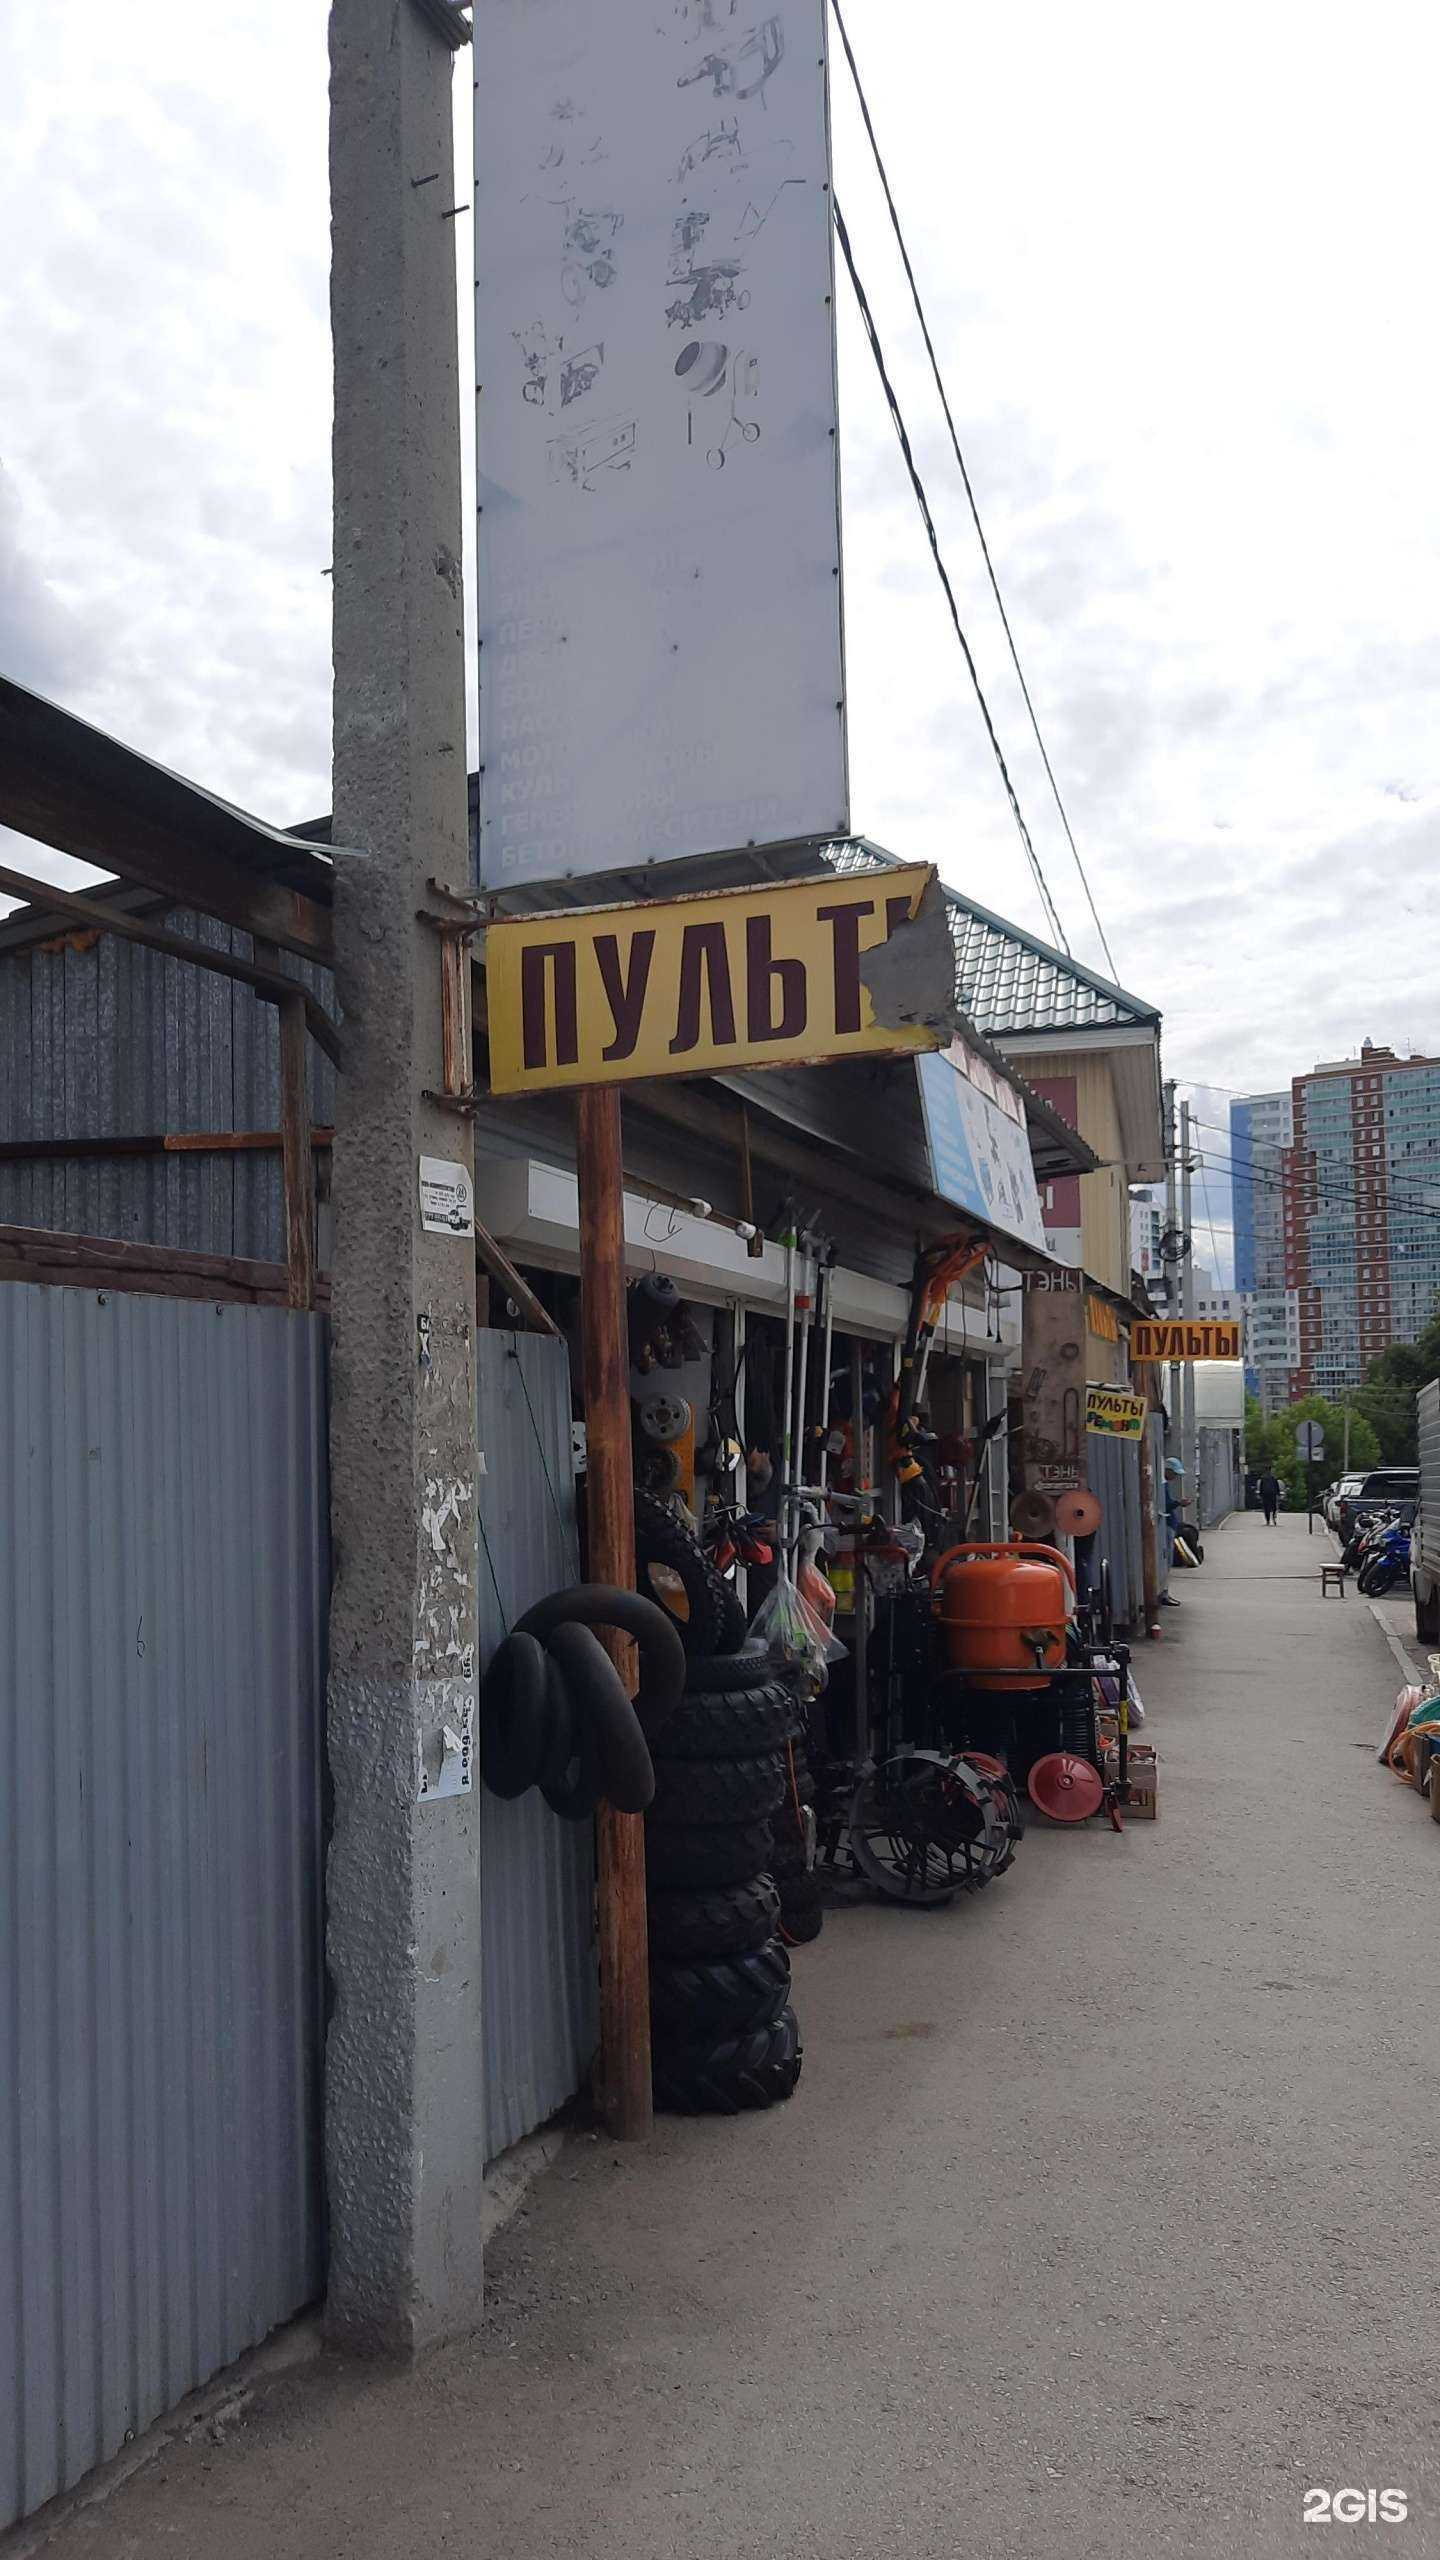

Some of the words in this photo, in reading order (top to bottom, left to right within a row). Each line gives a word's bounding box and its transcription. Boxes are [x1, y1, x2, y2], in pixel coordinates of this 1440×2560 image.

[521, 895, 913, 1070] ПУЛЬТ
[1136, 1326, 1238, 1355] ПУЛЬТЫ
[1087, 1394, 1144, 1416] ПУЛЬТЫ
